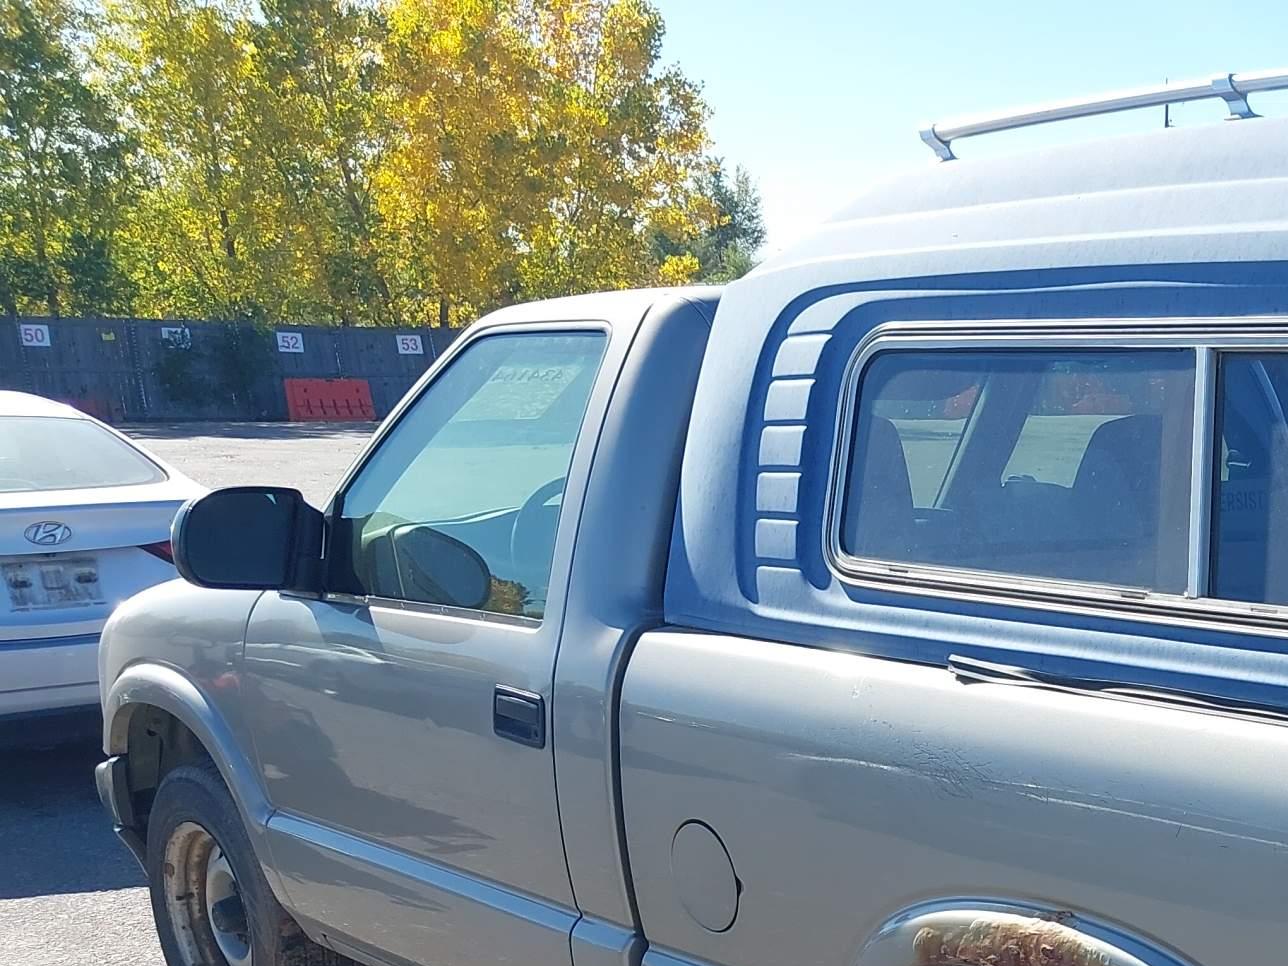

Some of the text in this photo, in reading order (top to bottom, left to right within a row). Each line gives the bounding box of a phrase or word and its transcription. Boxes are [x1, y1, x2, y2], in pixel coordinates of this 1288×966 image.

[23, 327, 45, 344] 50
[279, 335, 300, 350] 52
[401, 337, 419, 352] 53
